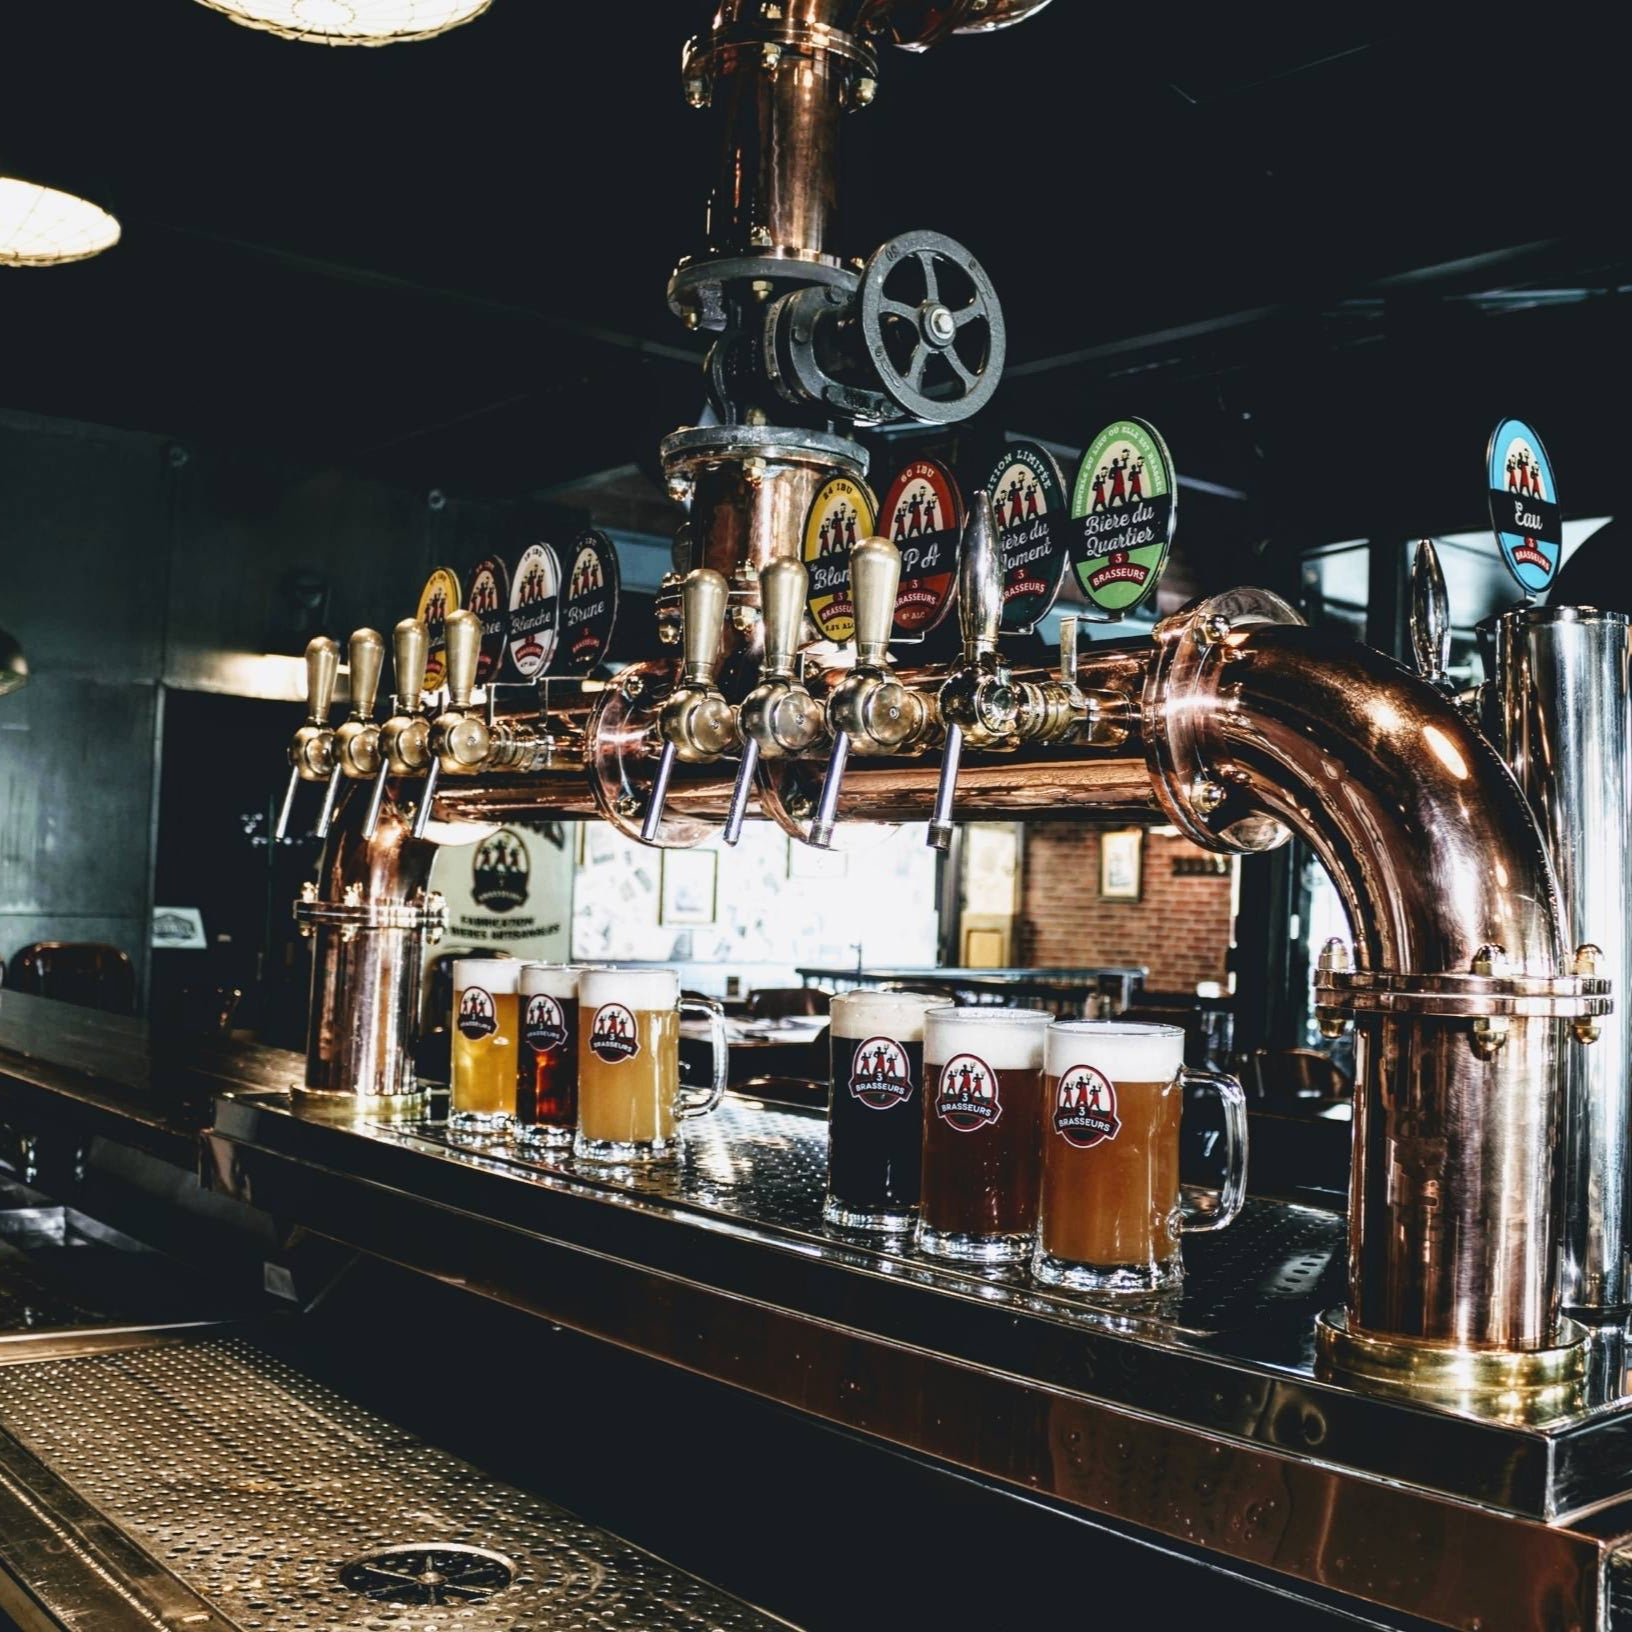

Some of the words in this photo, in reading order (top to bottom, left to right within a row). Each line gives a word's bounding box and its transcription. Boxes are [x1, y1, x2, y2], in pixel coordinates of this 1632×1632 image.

[986, 453, 1013, 496] ITION
[1084, 513, 1130, 537] Bière
[1131, 502, 1155, 523] du
[1514, 500, 1543, 530] Eau
[1001, 531, 1028, 552] ière
[1028, 519, 1050, 541] du
[1086, 526, 1155, 558] Quartier
[899, 542, 942, 573] PA
[1115, 553, 1122, 563] 3
[813, 565, 850, 591] Blon
[1017, 569, 1025, 579] 3
[1093, 567, 1145, 587] BRASSEURS
[1003, 581, 1046, 600] RASSEURS
[567, 600, 606, 627] Brune
[822, 604, 854, 621] BRASSEU
[608, 1033, 616, 1042] 3
[876, 1072, 884, 1082] 3
[855, 1081, 906, 1096] BRASSEURS
[961, 1092, 969, 1102] 3
[941, 1102, 993, 1118] BRASSEURS
[1078, 1106, 1087, 1116] 3
[1058, 1117, 1111, 1133] BRASSEURS
